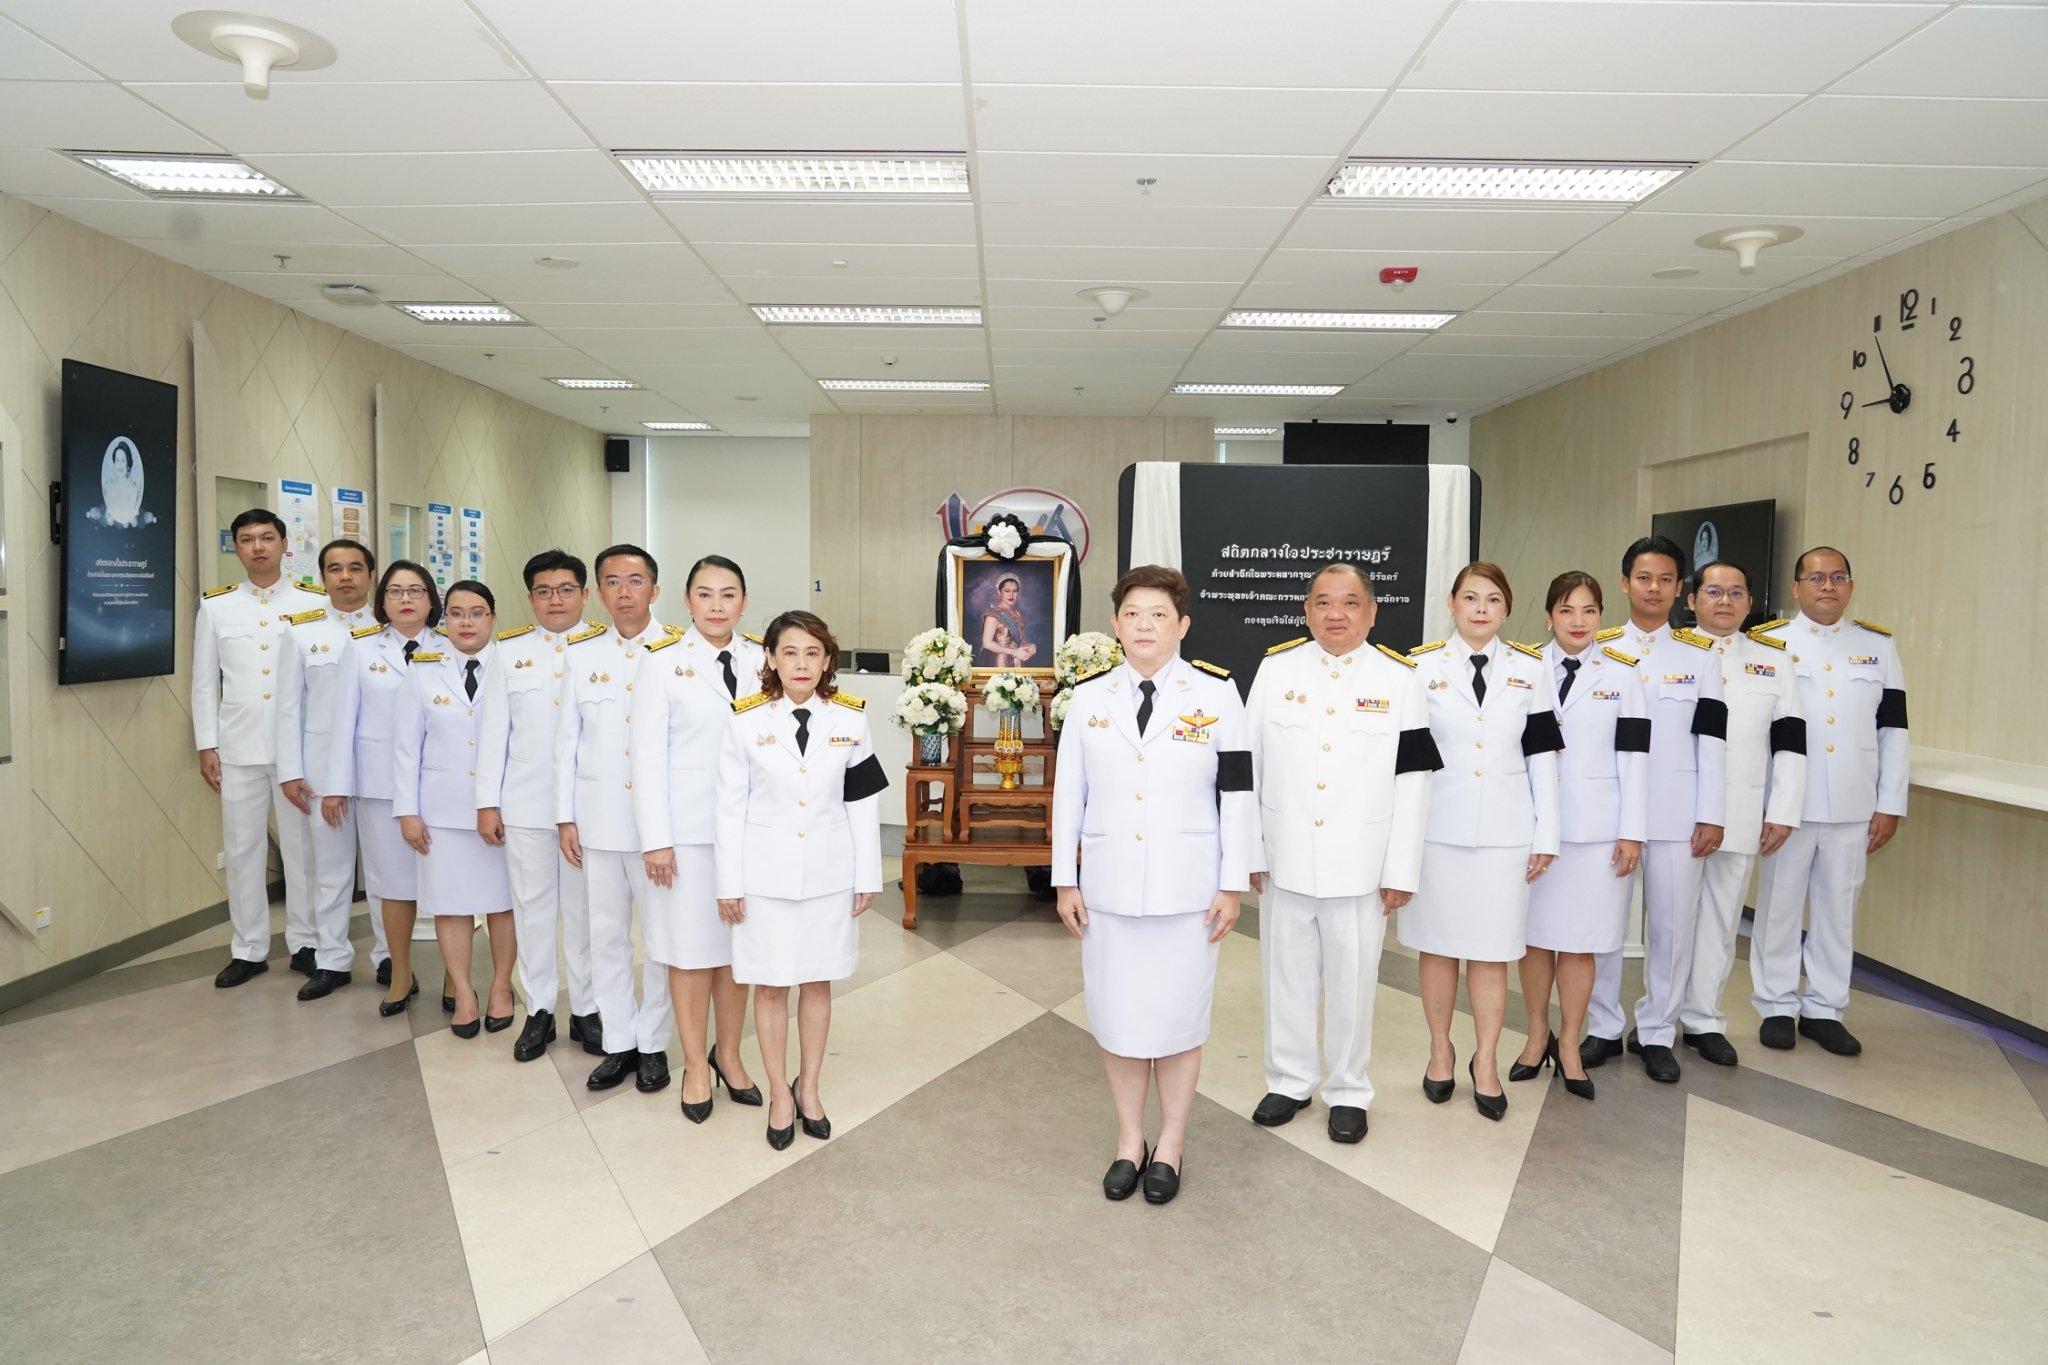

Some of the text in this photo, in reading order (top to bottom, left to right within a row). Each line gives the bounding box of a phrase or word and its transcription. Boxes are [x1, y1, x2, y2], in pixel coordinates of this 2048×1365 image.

[1900, 289, 1919, 323] 12
[1931, 297, 1936, 315] 1
[1949, 317, 1962, 341] 2
[1853, 350, 1867, 370] 10
[1957, 357, 1974, 394] 3
[1840, 391, 1853, 420] 9
[1946, 418, 1960, 442] 4
[1848, 437, 1860, 465] 8
[1866, 472, 1875, 488] 7
[1922, 462, 1936, 489] 5
[1889, 475, 1904, 505] 6
[814, 580, 822, 592] 1
[1211, 568, 1315, 581] ด้วยสำนึกในพระมหากรุณ
